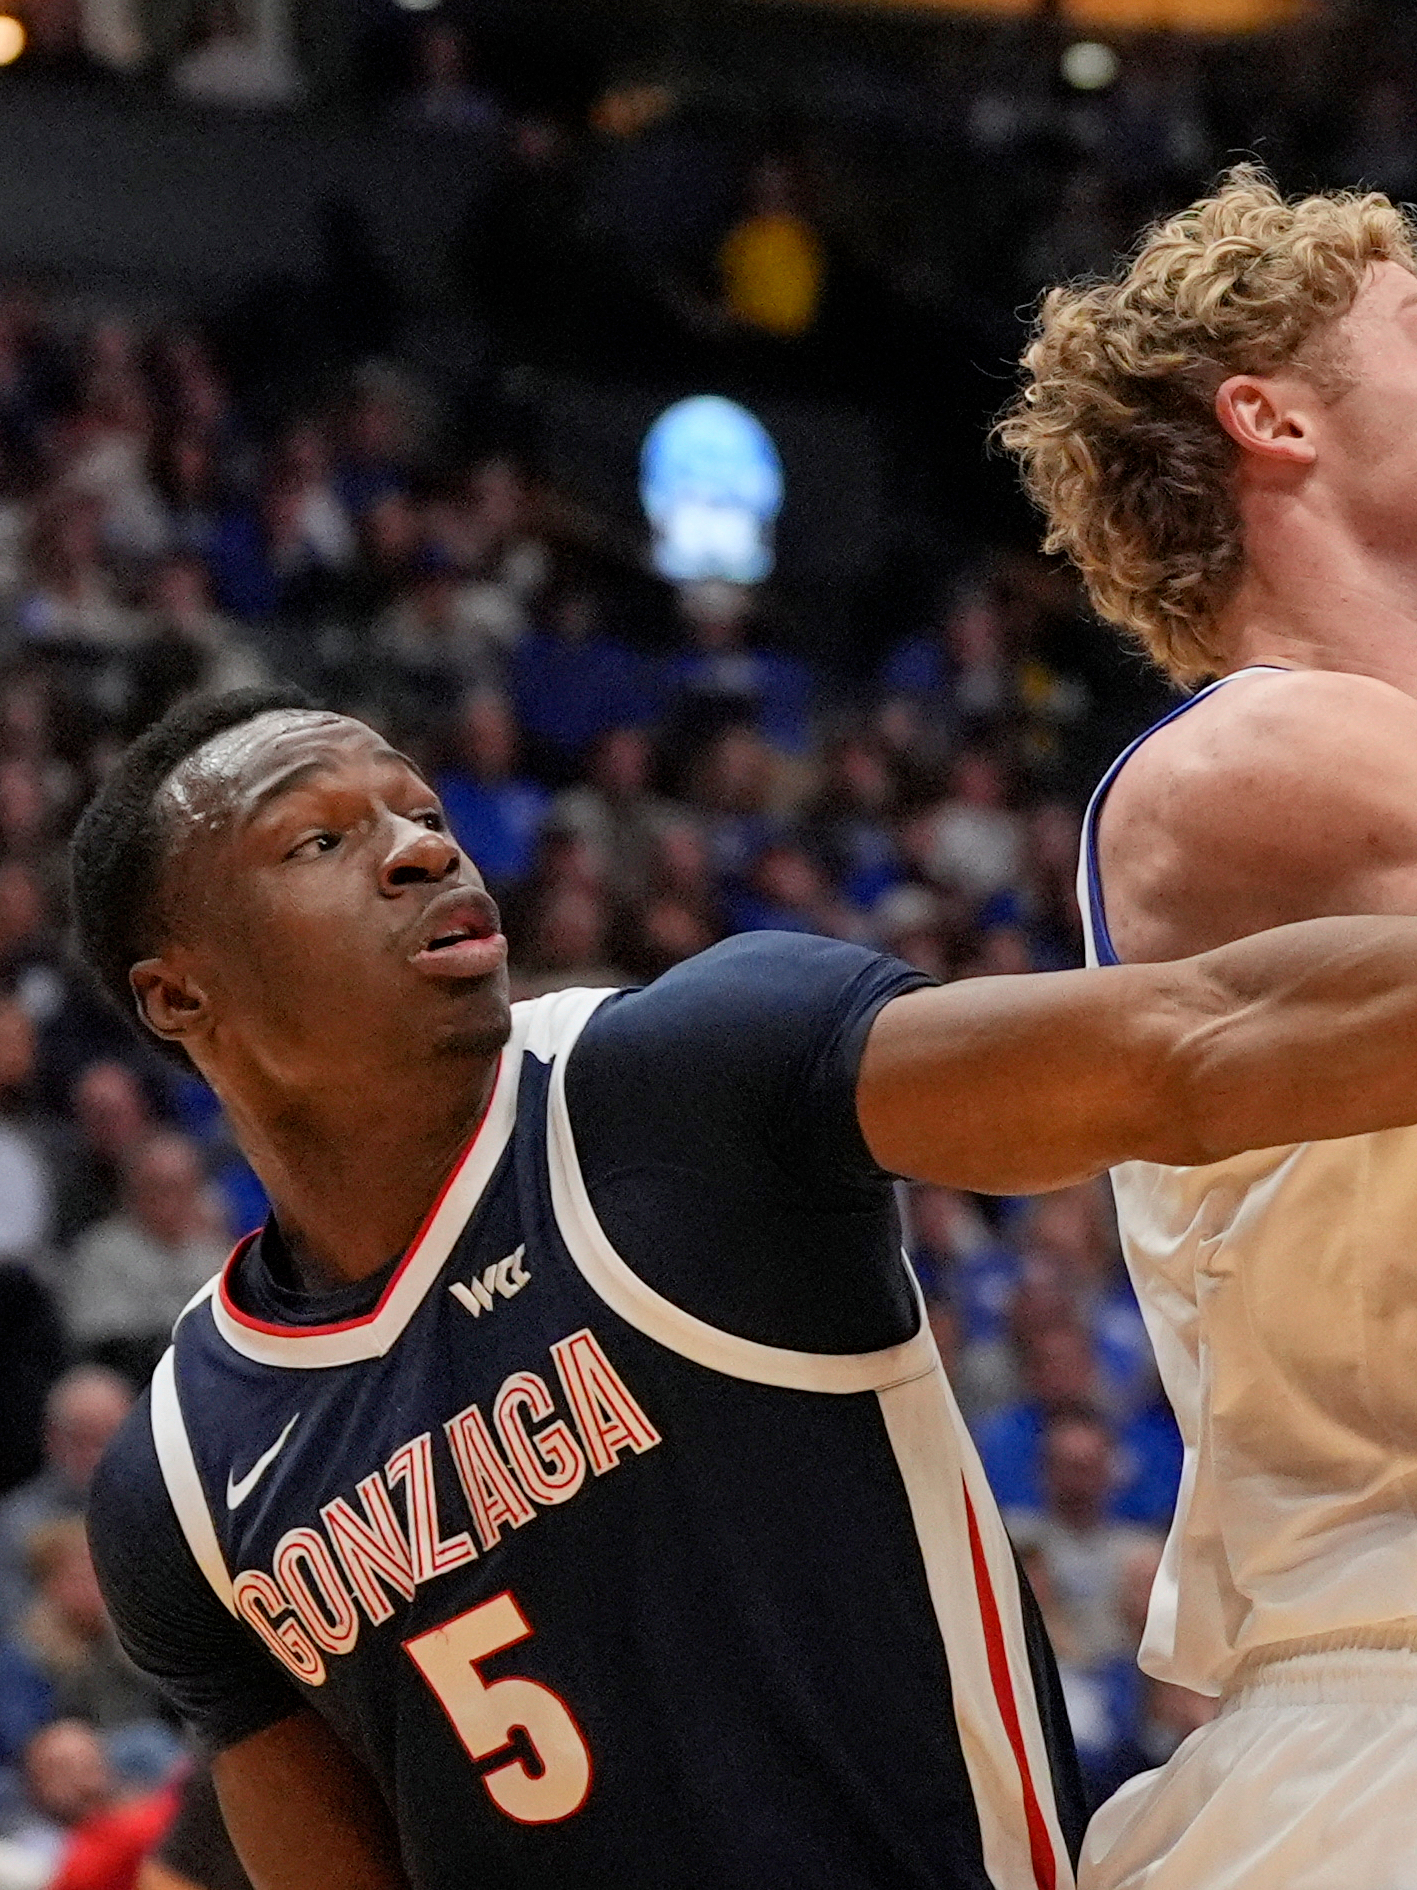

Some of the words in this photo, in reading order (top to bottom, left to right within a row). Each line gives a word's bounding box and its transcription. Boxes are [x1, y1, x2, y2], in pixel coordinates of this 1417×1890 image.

[448, 1243, 532, 1318] WCC
[232, 1328, 662, 1686] GONZAGA
[402, 1590, 594, 1825] 5
